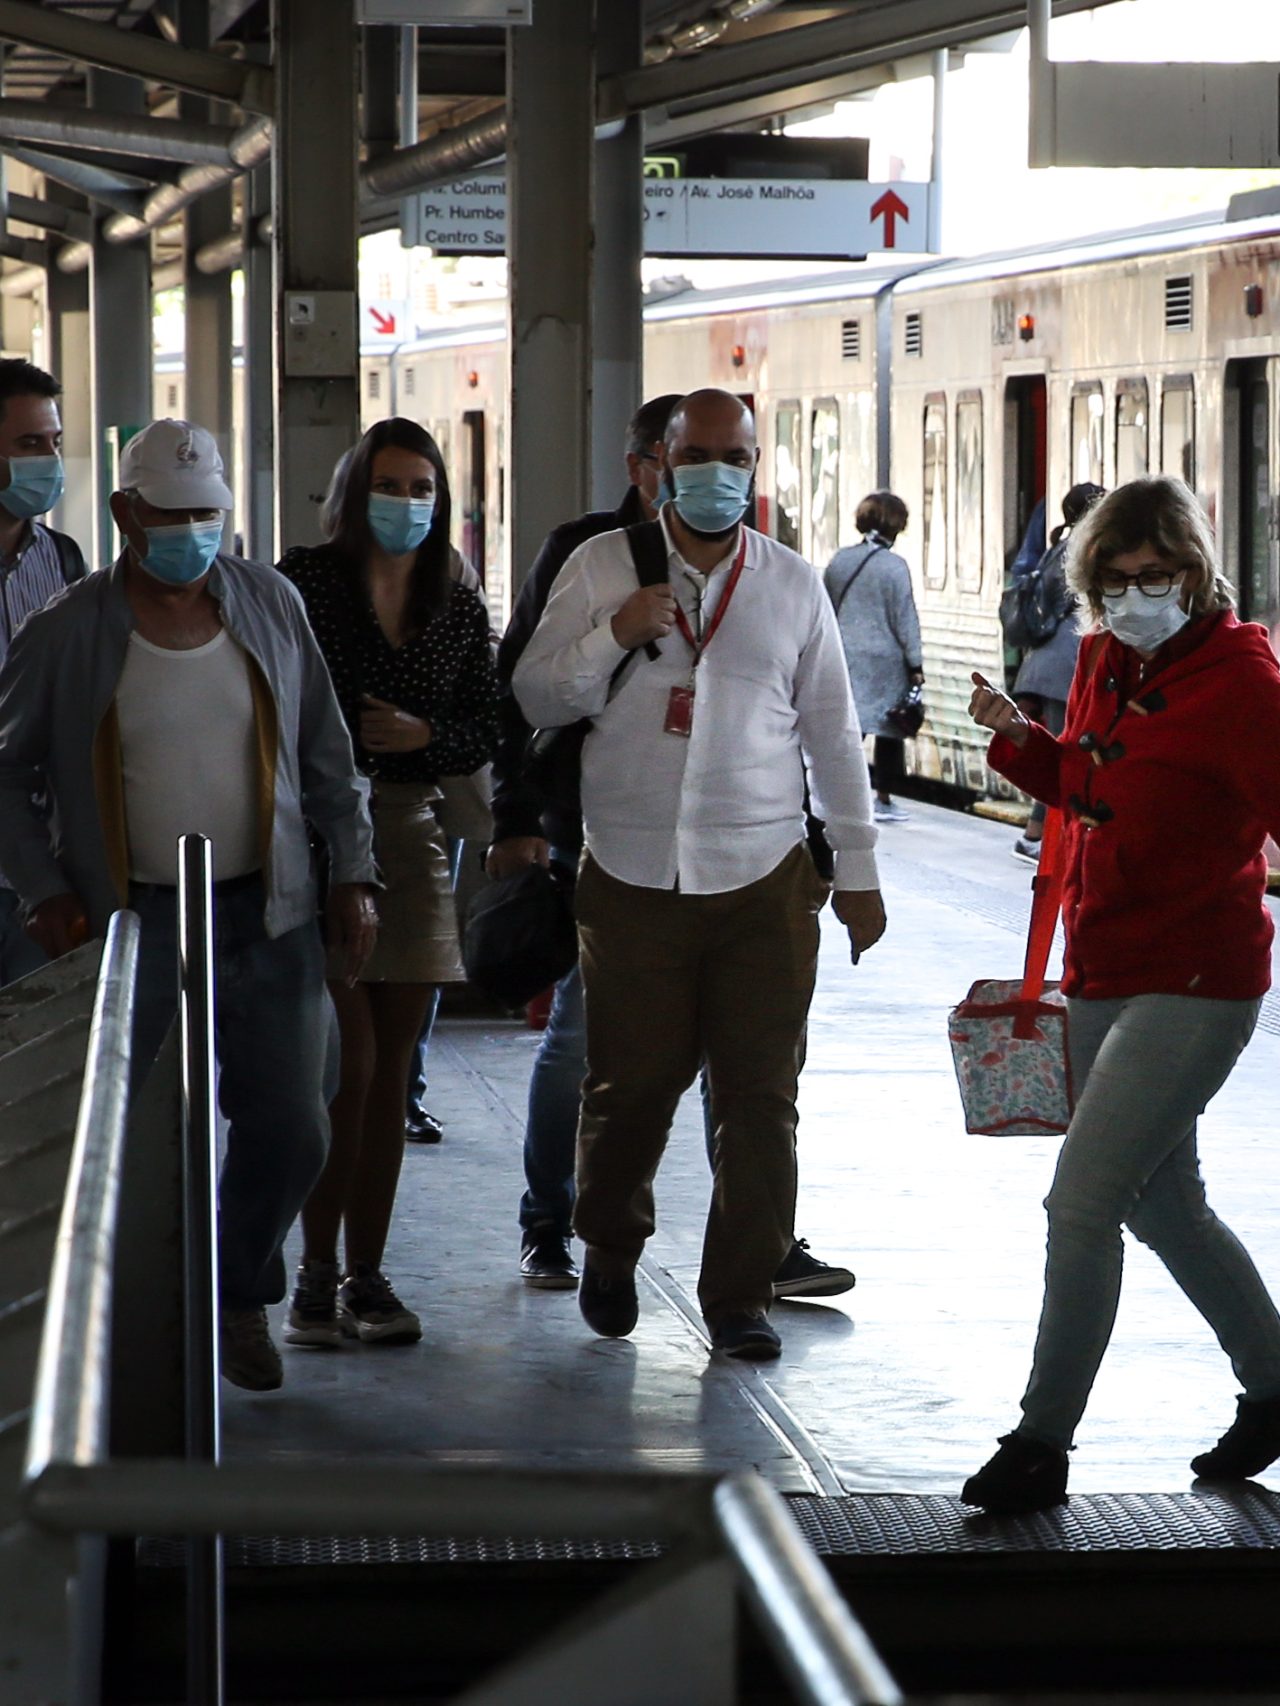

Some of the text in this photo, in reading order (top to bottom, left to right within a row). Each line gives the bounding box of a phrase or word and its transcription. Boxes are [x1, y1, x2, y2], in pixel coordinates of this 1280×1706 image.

[691, 185, 710, 198] Av.
[717, 184, 754, 199] José
[424, 204, 443, 219] Pr.
[425, 229, 479, 244] Centro
